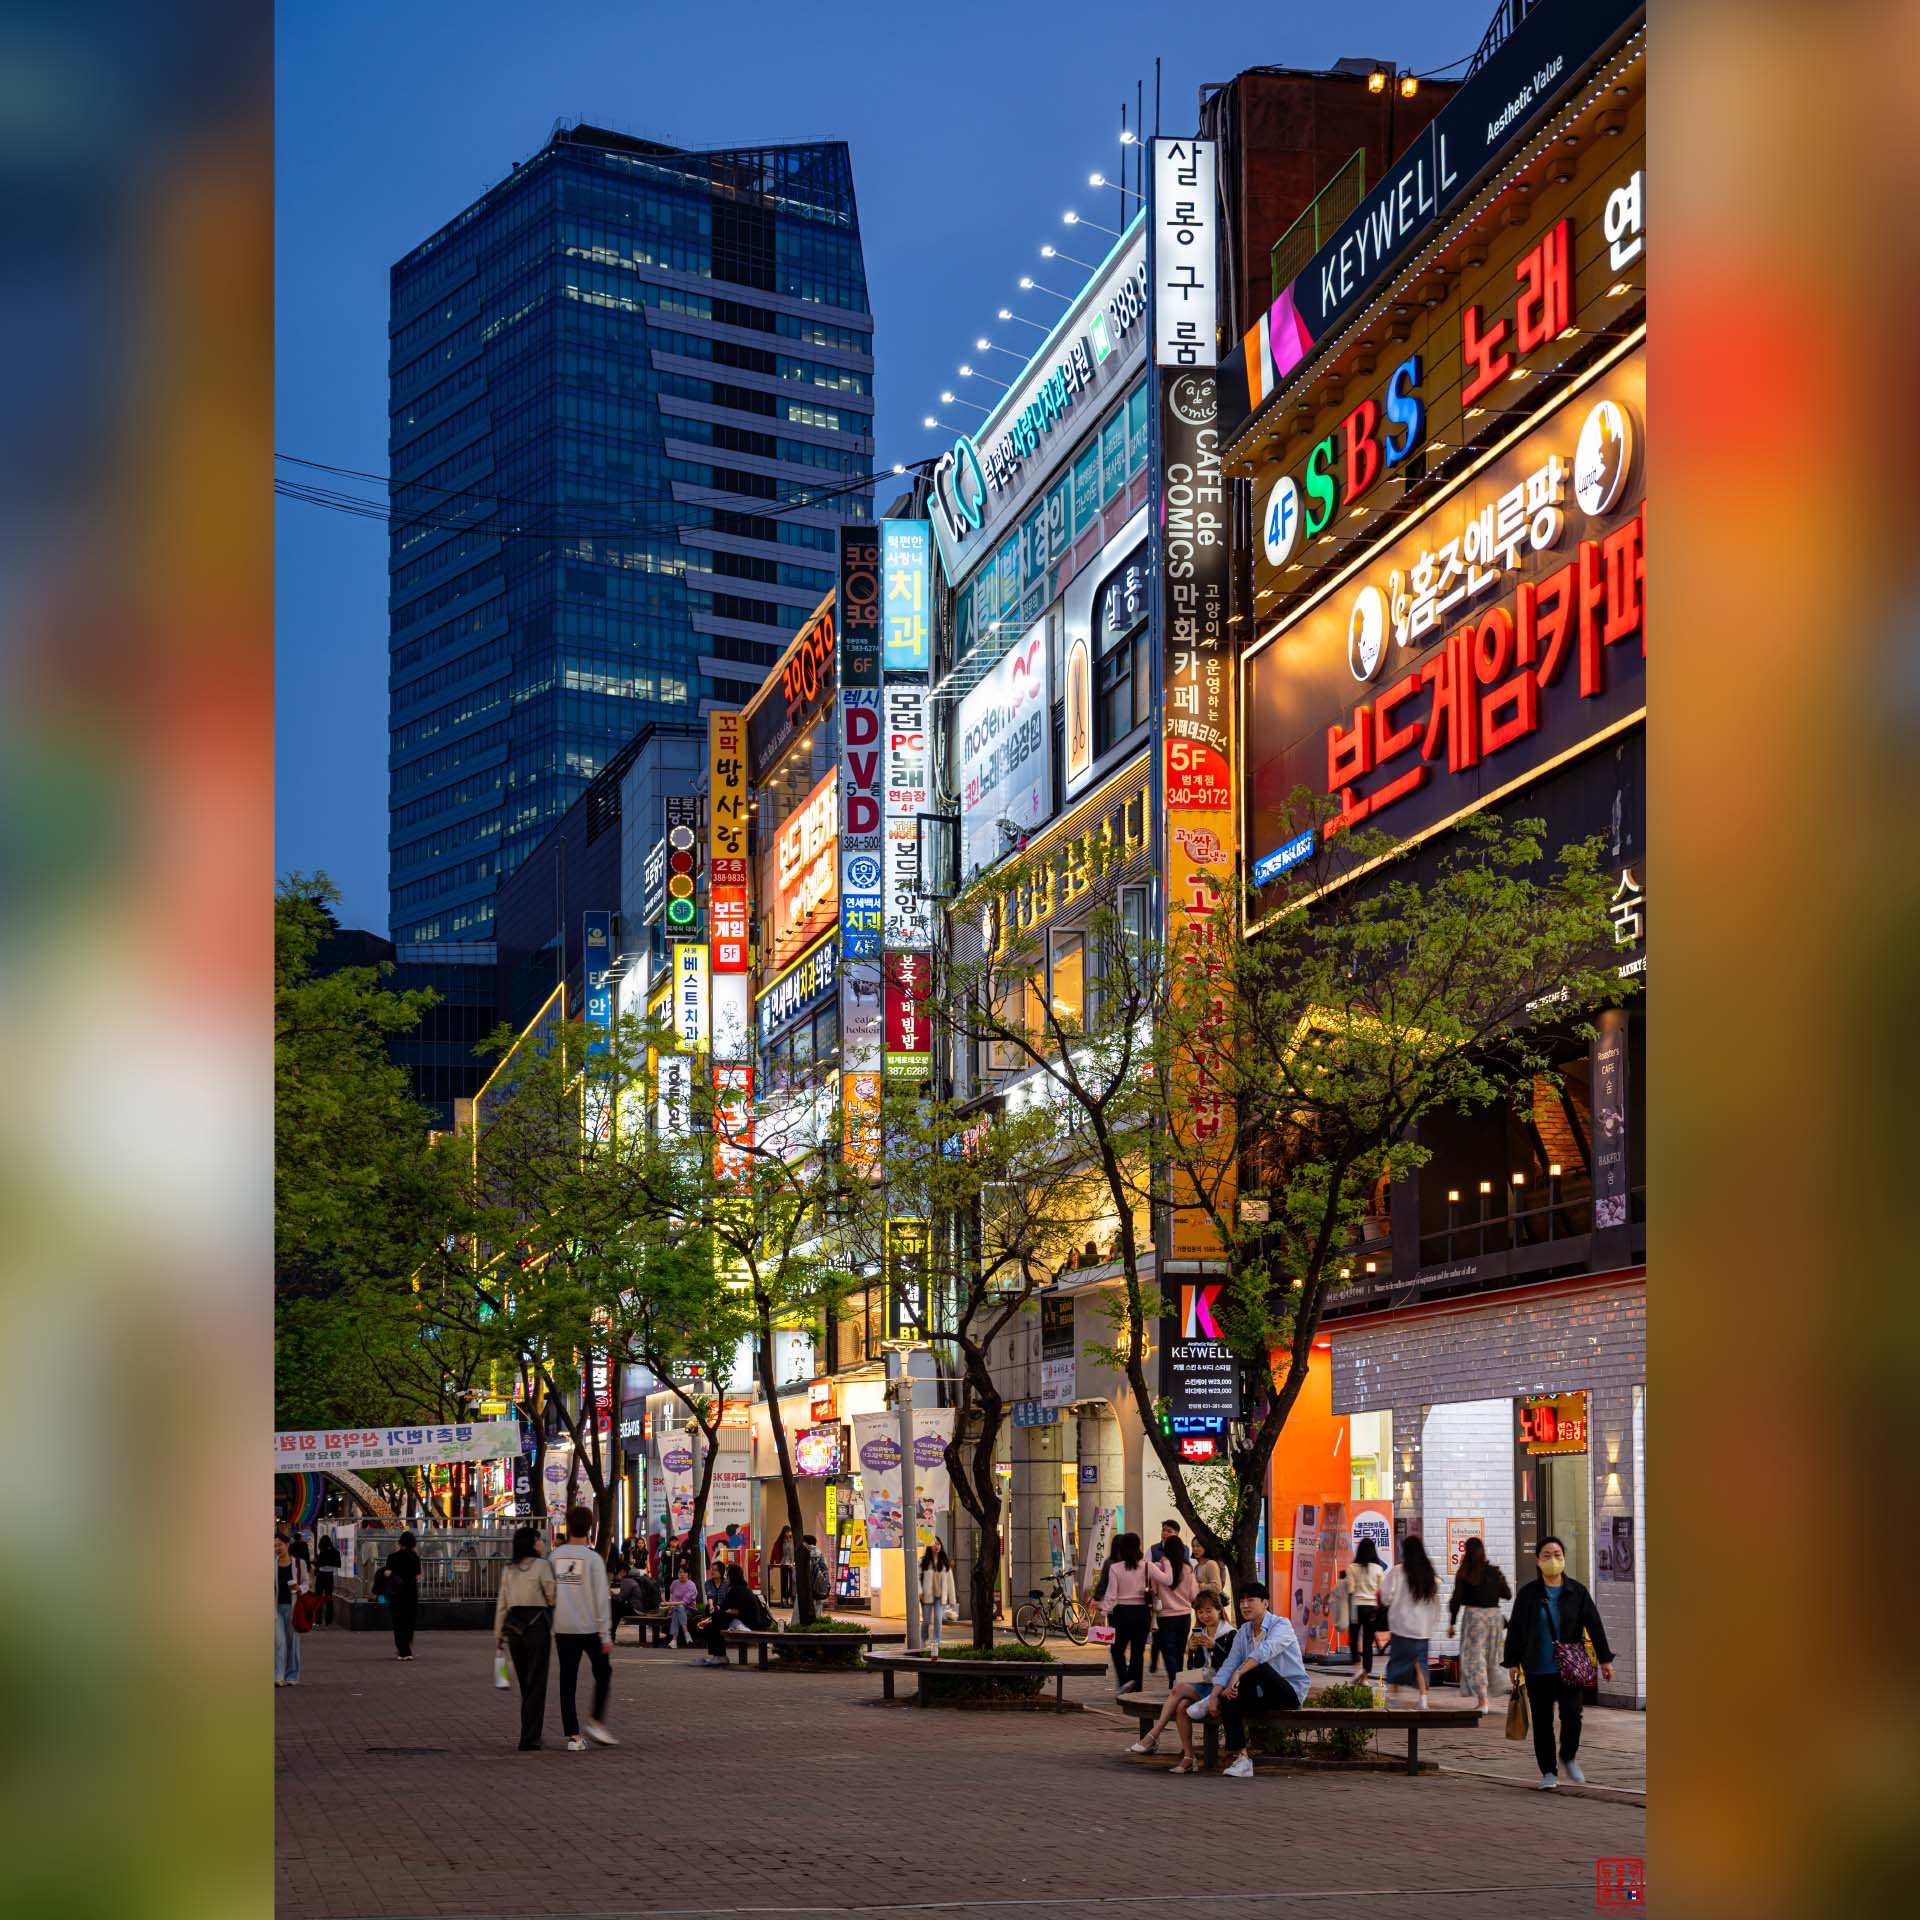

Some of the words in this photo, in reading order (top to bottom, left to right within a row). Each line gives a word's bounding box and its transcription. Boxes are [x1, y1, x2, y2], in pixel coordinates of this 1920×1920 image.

[1486, 86, 1532, 145] Aesthetic
[1533, 54, 1564, 96] Value
[1321, 132, 1458, 318] KEYWELL
[1267, 490, 1295, 548] 4F
[1305, 355, 1425, 540] SBS
[1197, 428, 1223, 505] CAFE
[1167, 463, 1195, 579] COMICS
[887, 535, 924, 549] 턱편한
[1407, 454, 1571, 641] 홈즈앤루팡
[886, 552, 924, 566] 사랑니
[887, 569, 929, 657] 치과
[1172, 583, 1200, 717] 만화카페
[853, 657, 873, 673] 6F
[842, 689, 880, 708] 렉시
[1205, 658, 1222, 722] 운영하는
[889, 692, 923, 732] 모던
[891, 734, 925, 752] PC
[1167, 718, 1229, 752] 카페데코믹스
[1169, 743, 1208, 772] 5F
[845, 707, 880, 835] DVD
[891, 751, 923, 789] 노래
[1181, 774, 1215, 787] 범계점
[888, 790, 927, 802] 연습장
[1168, 787, 1229, 806] 340-9172
[900, 803, 915, 813] 4F
[668, 812, 695, 826] 당구
[715, 860, 743, 872] 2층
[712, 873, 745, 883] 388-9835
[676, 906, 688, 915] 5F
[714, 901, 745, 919] 보드
[714, 920, 745, 938] 게임
[722, 946, 738, 960] 5F
[683, 956, 699, 1042] 베스트치과
[1597, 1047, 1620, 1061] Roasters
[887, 1066, 929, 1077] 387.6288
[1601, 1063, 1616, 1075] CAFE
[1597, 1151, 1622, 1165] BAKERY
[900, 1326, 919, 1341] B1
[1171, 1347, 1234, 1359] KEYWELL
[1353, 1528, 1390, 1539] 보드게임
